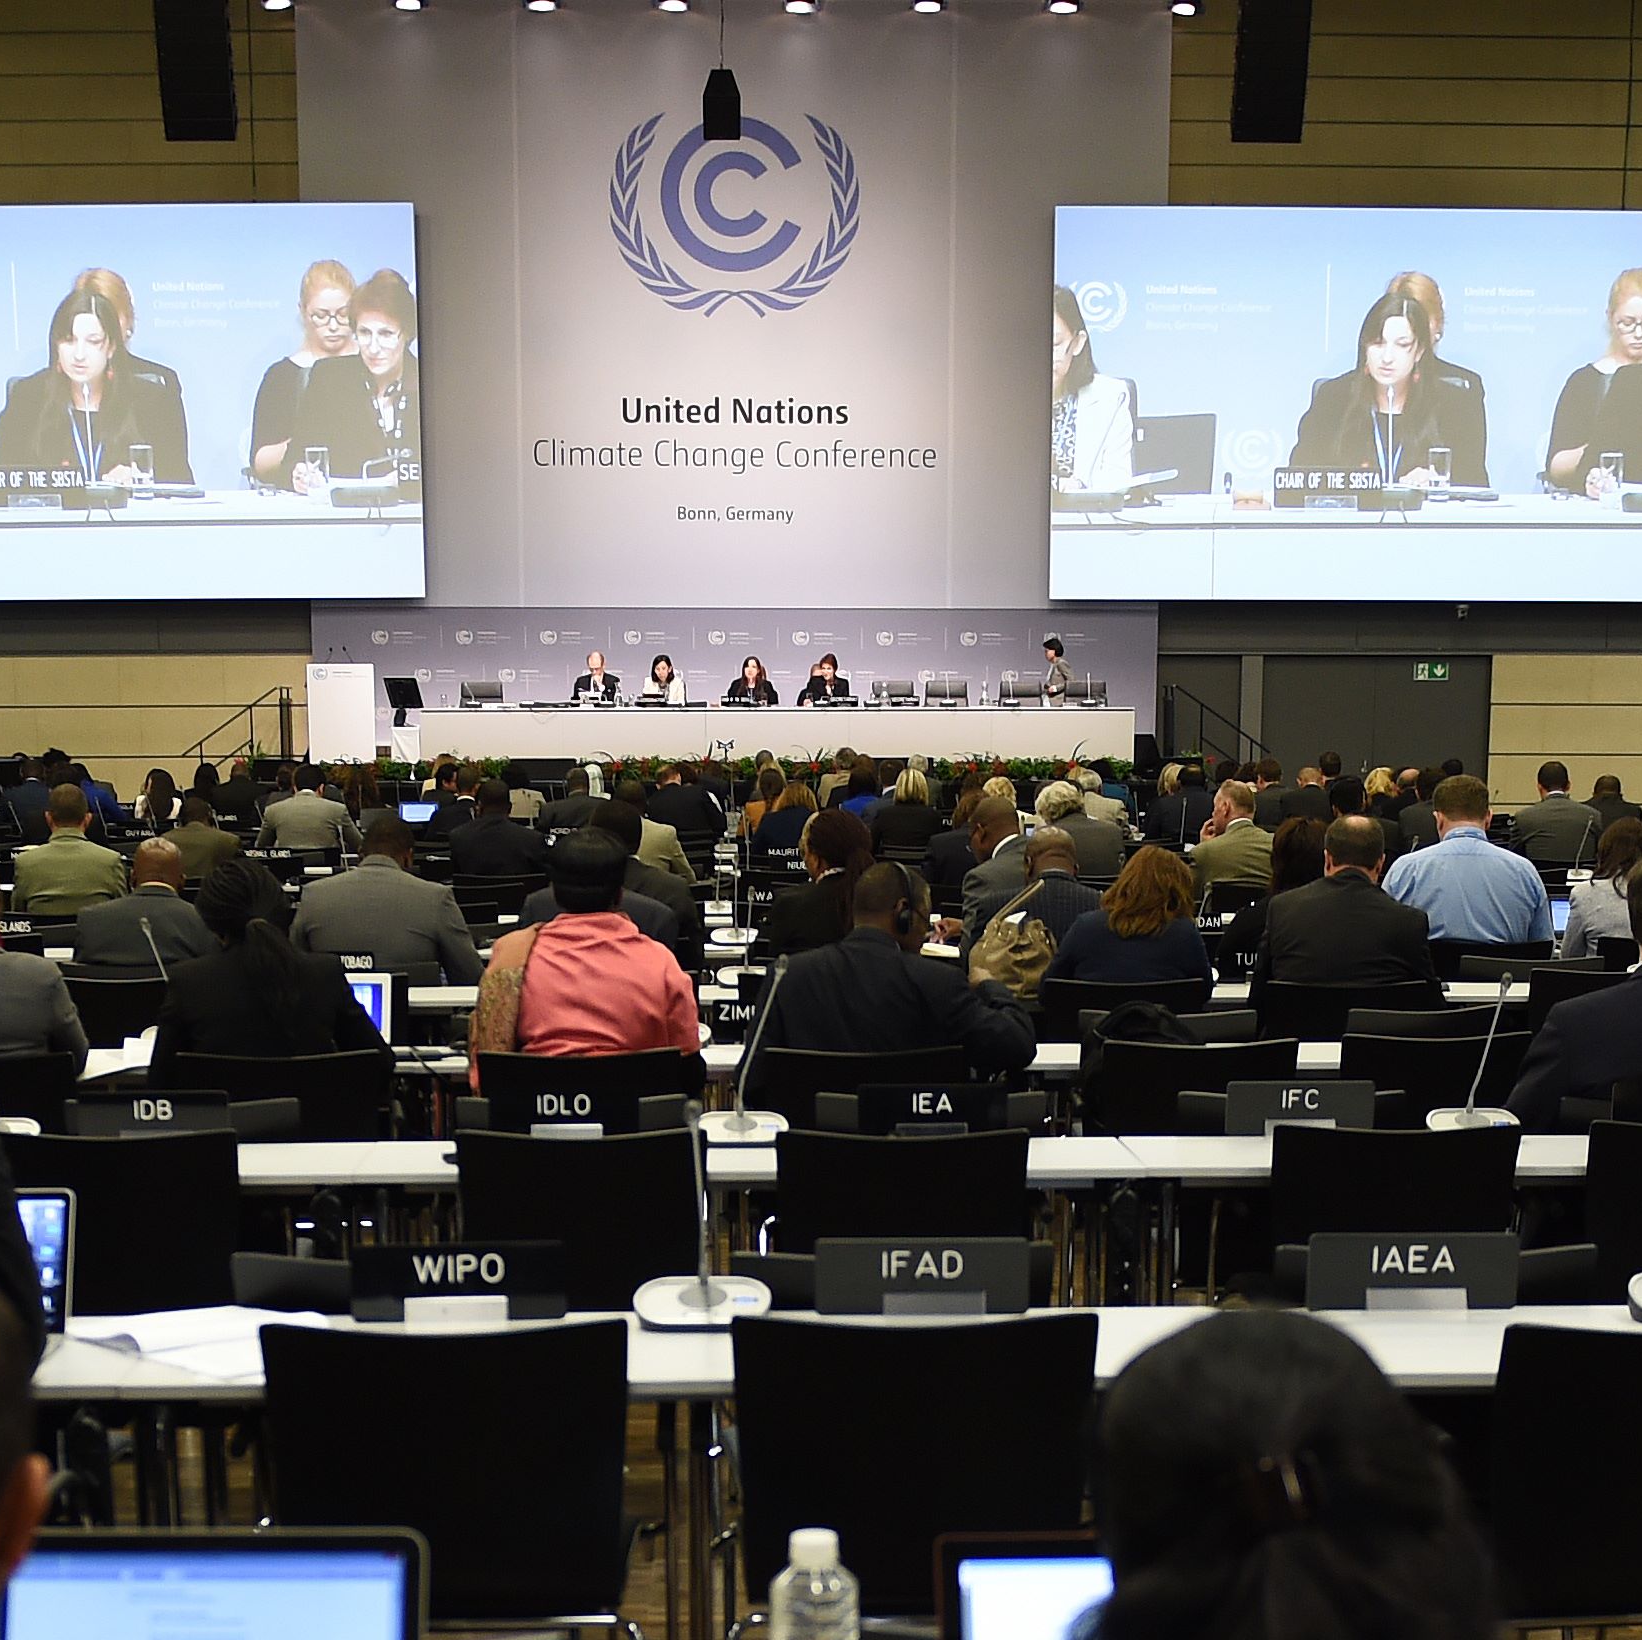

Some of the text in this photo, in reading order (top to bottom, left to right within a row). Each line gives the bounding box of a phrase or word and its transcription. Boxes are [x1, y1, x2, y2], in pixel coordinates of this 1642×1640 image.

[622, 396, 849, 425] United Nations
[533, 438, 937, 475] Climate Change Conference
[9, 471, 24, 488] OF
[28, 471, 47, 488] THE
[51, 470, 84, 488] SBSTA
[1275, 472, 1381, 490] CHAIR OF THE SBSTA
[677, 506, 794, 525] Bonn, Germany
[0, 920, 31, 933] SLANDS
[1198, 916, 1221, 928] DAN
[133, 1099, 174, 1121] IDB
[536, 1093, 591, 1116] IDLO
[912, 1092, 953, 1114] IEA
[1281, 1088, 1319, 1110] IFC
[413, 1252, 505, 1284] WIPO
[881, 1249, 964, 1279] IFAD
[1371, 1244, 1455, 1274] IAEA
